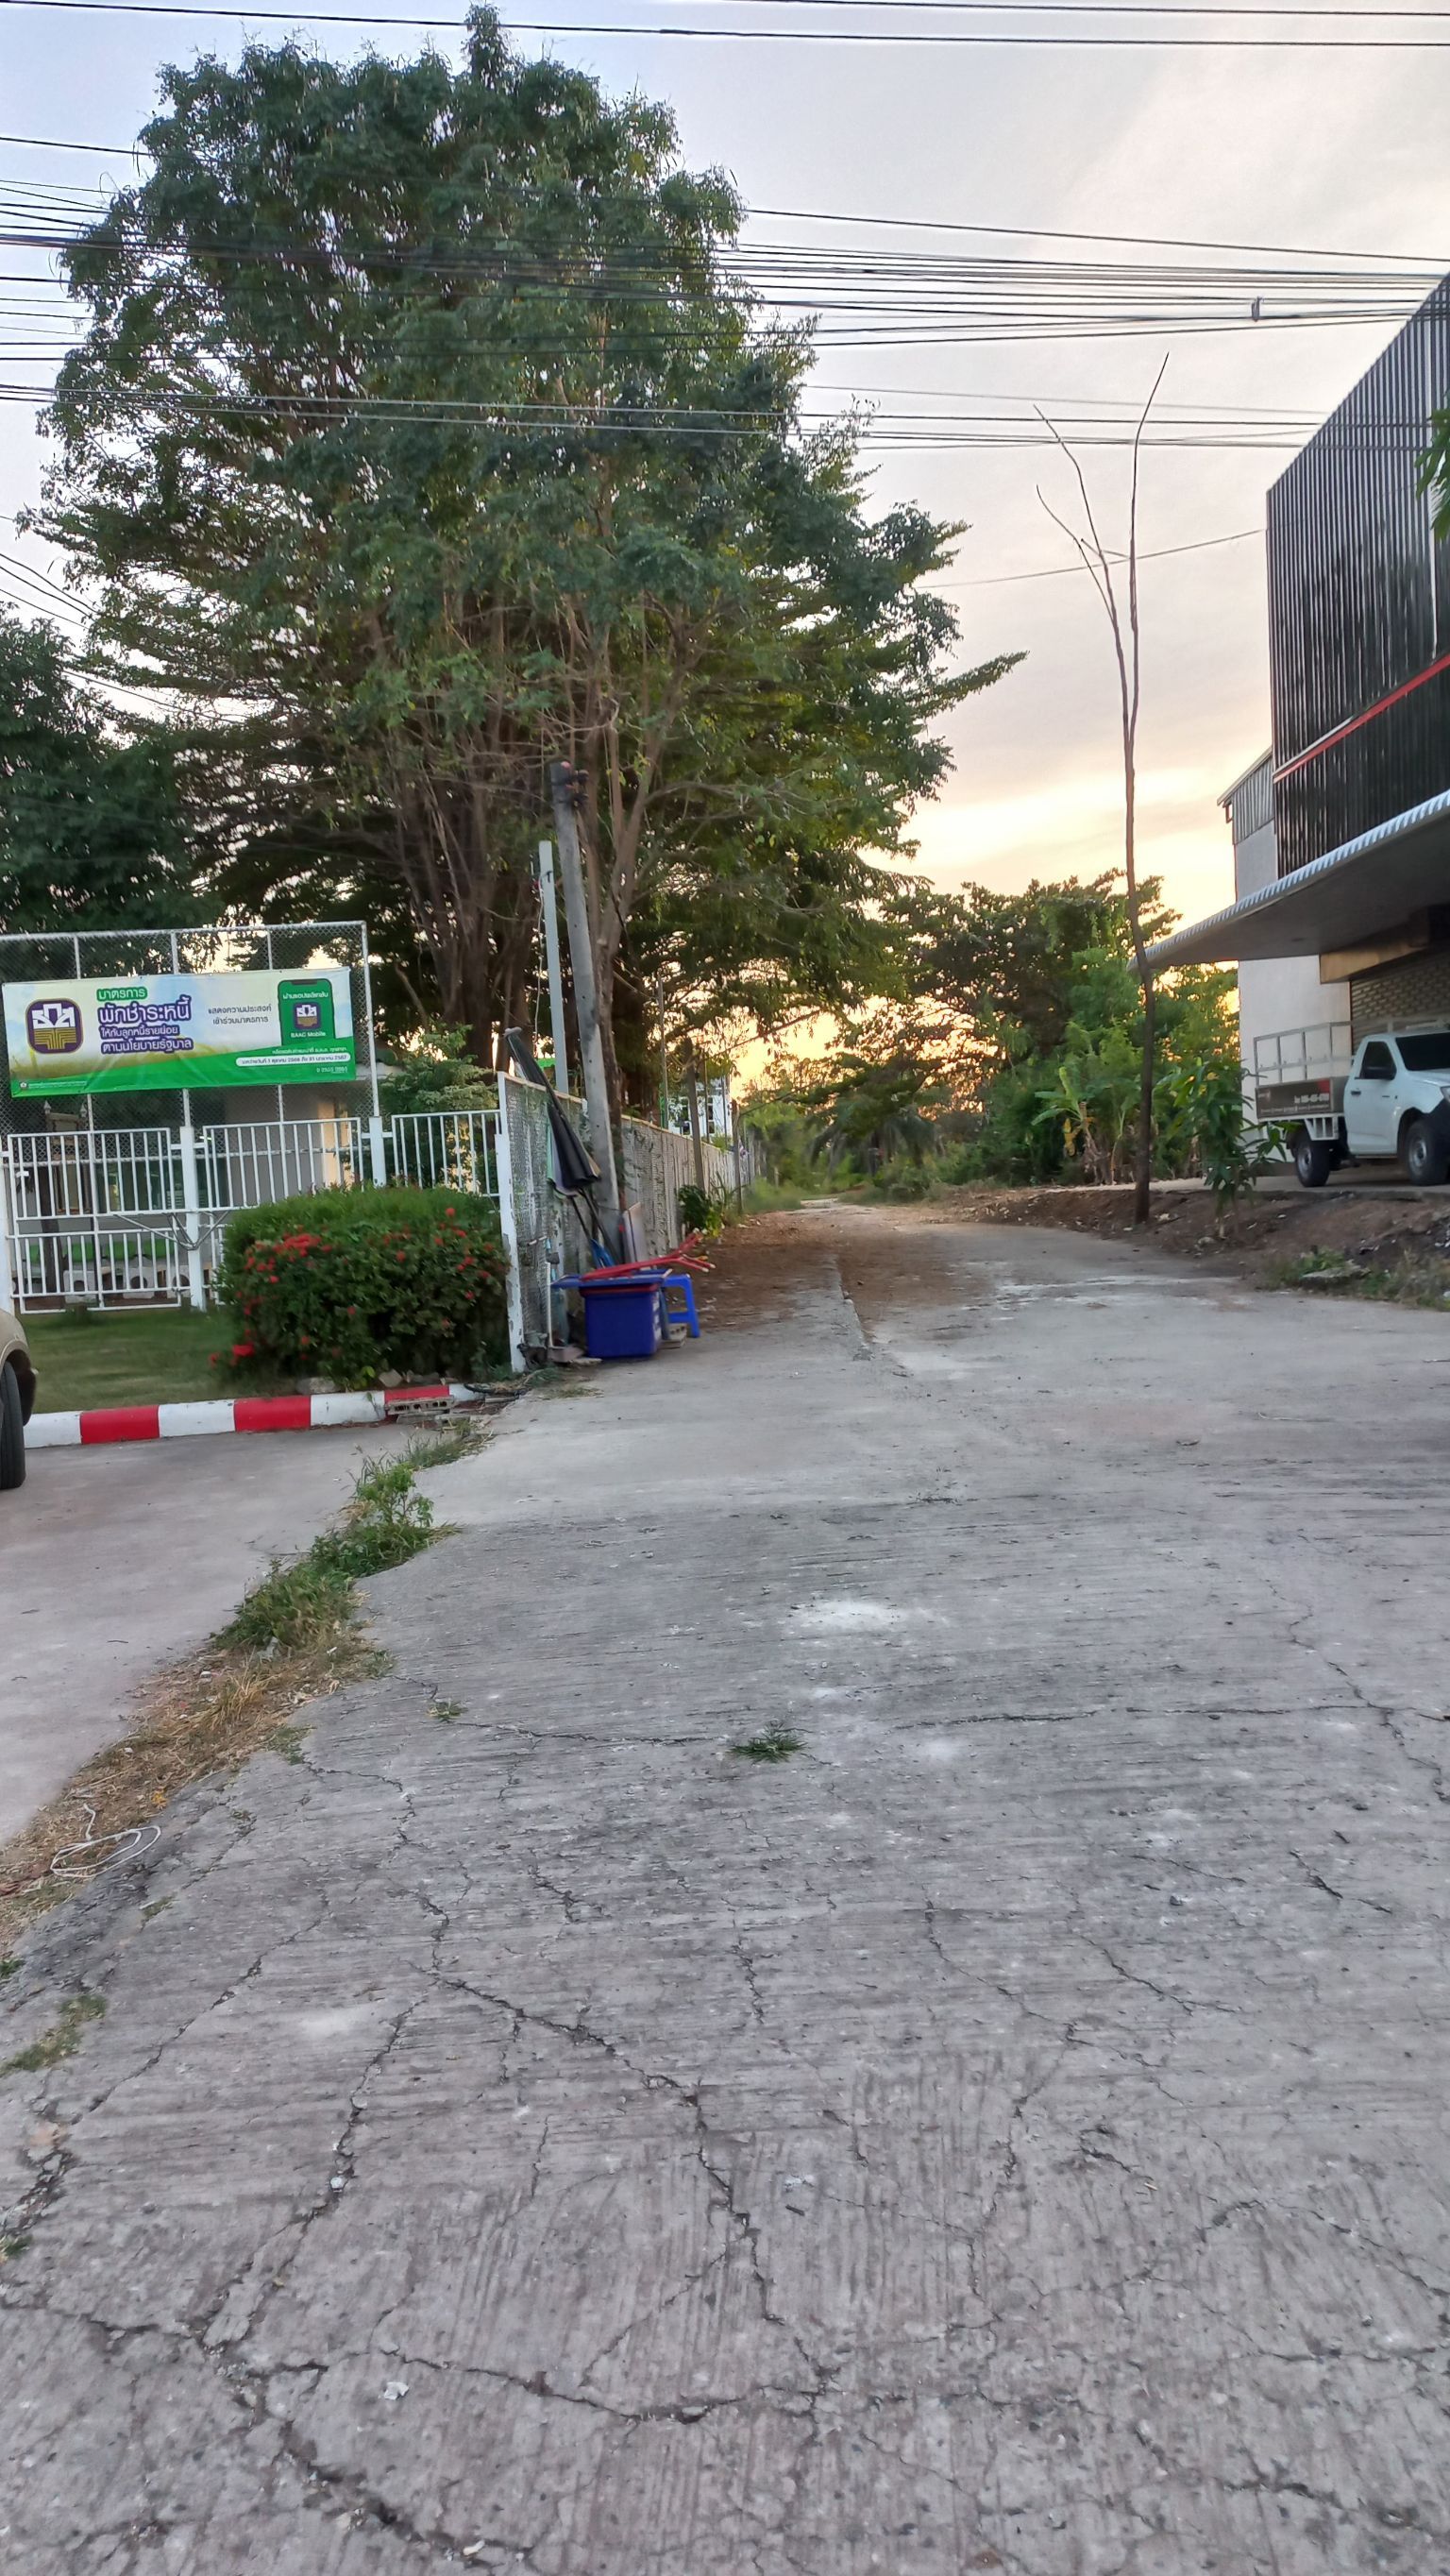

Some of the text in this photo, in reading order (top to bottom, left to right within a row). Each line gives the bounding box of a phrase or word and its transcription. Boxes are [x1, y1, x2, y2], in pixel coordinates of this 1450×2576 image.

[98, 988, 145, 1000] มาตรการ
[99, 996, 189, 1023] พักชำระหนี้
[103, 1039, 192, 1052] ตามนโยบายรัฐบาล
